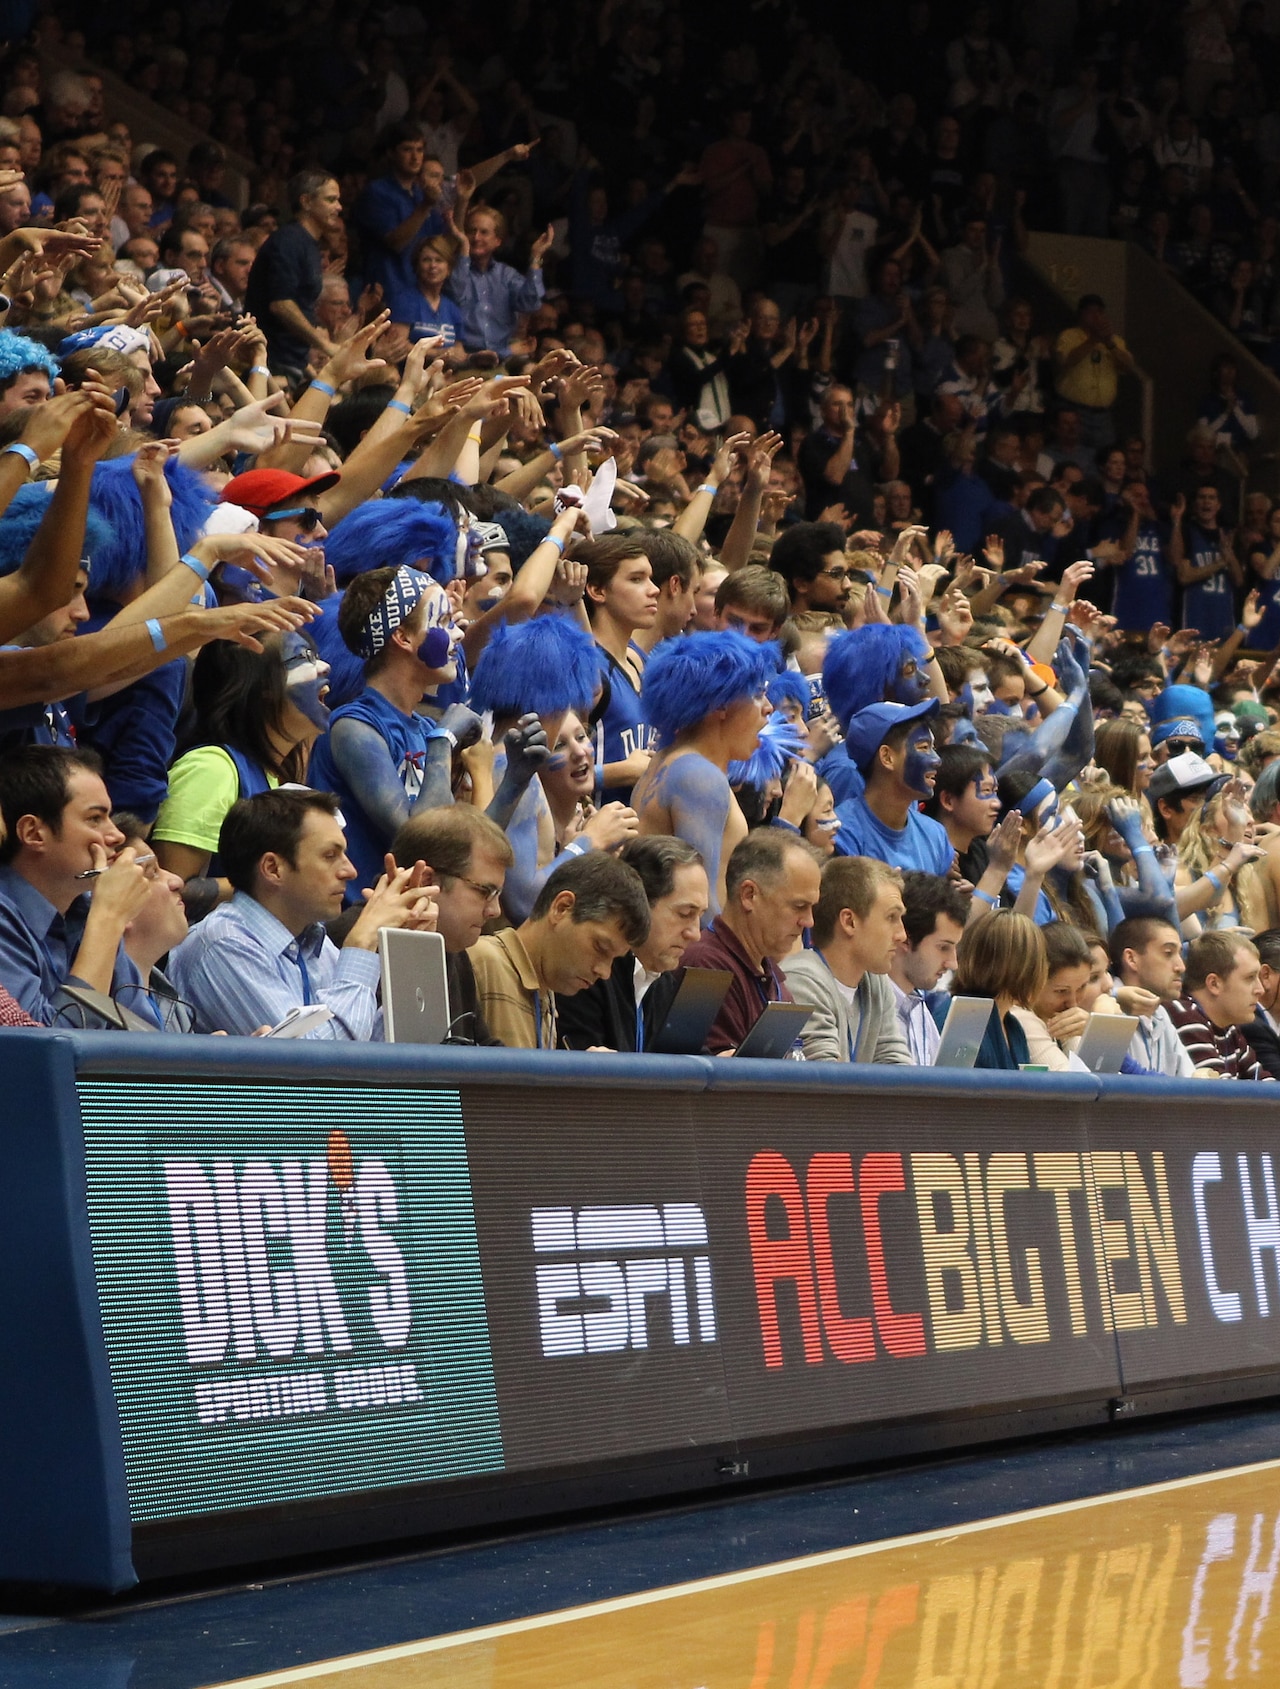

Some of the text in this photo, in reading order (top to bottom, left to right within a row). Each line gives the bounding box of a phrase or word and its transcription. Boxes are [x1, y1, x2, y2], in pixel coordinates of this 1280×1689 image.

[1135, 555, 1159, 576] 31
[1202, 573, 1226, 594] 31
[163, 1153, 413, 1366] DICK'S
[531, 1203, 716, 1357] ESPN
[745, 1148, 926, 1369] ACC
